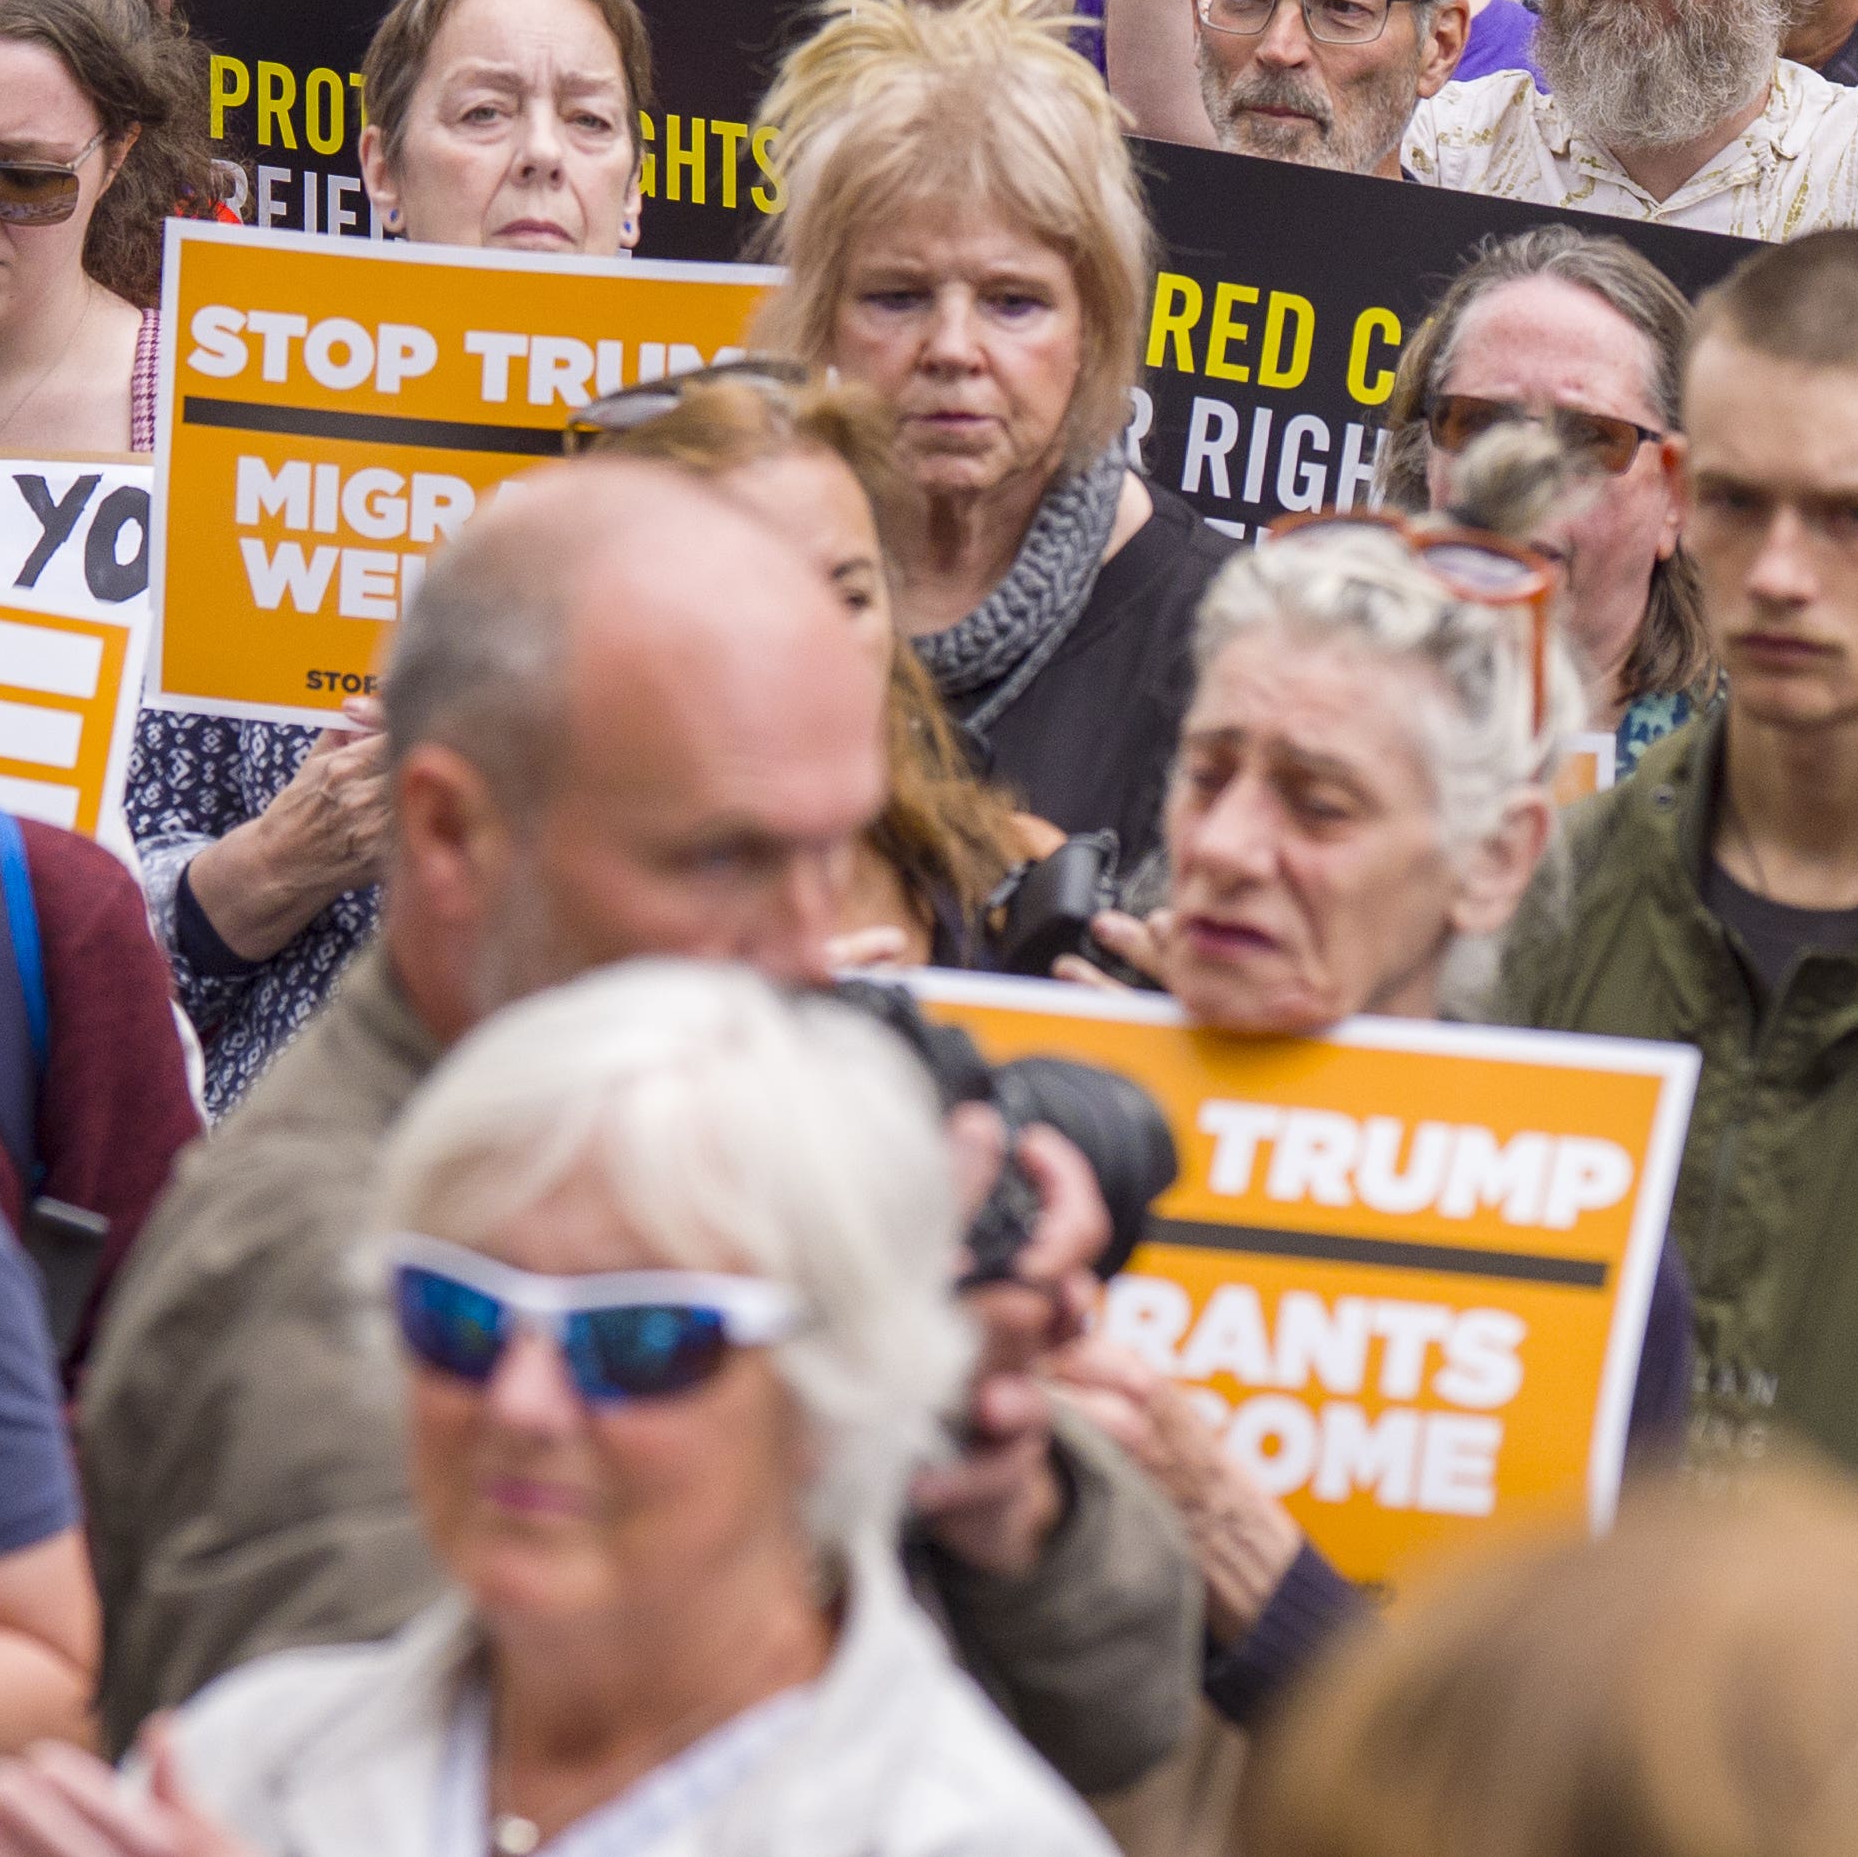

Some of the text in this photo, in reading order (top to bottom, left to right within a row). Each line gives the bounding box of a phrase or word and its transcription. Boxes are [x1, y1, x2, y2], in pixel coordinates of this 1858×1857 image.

[186, 304, 438, 394] STOP
[1145, 271, 1315, 390] RED
[1197, 1098, 1635, 1231] TRUMP
[1102, 1274, 1529, 1409] RANTS
